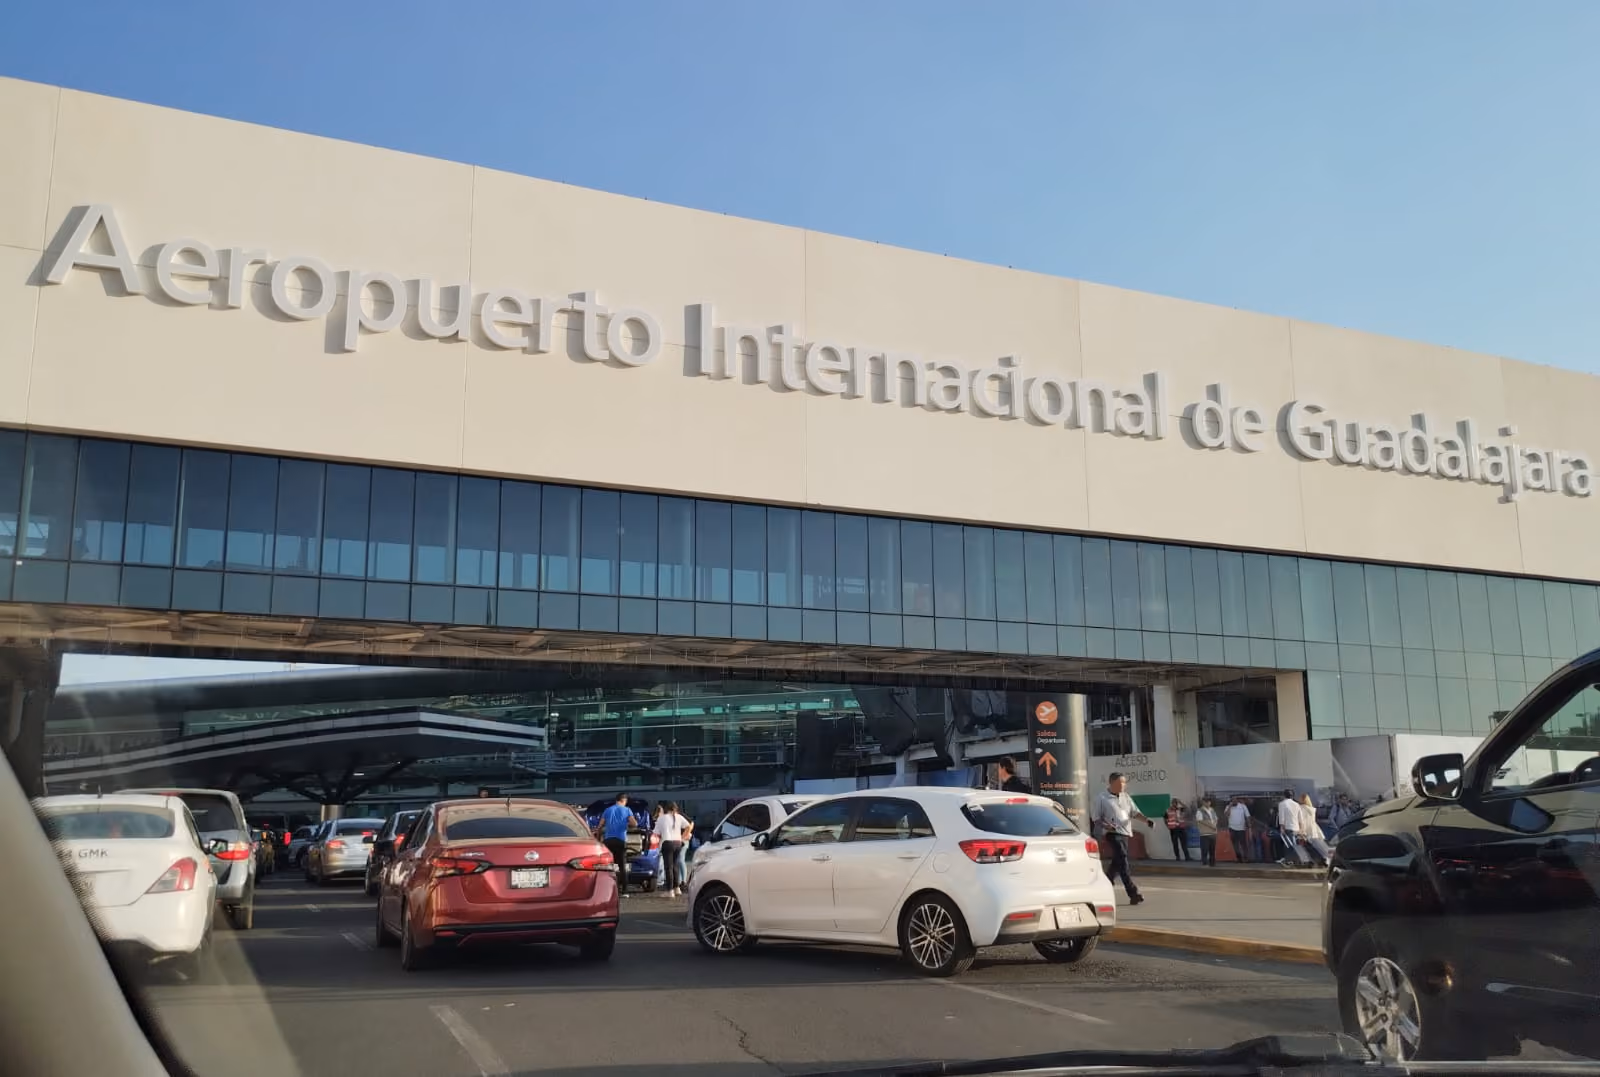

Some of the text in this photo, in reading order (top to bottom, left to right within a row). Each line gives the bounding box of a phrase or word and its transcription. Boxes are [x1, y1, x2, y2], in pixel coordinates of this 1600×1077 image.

[40, 202, 1594, 502] Aeropuerto Internacional de Guadalajara
[1114, 754, 1150, 769] ACCESO
